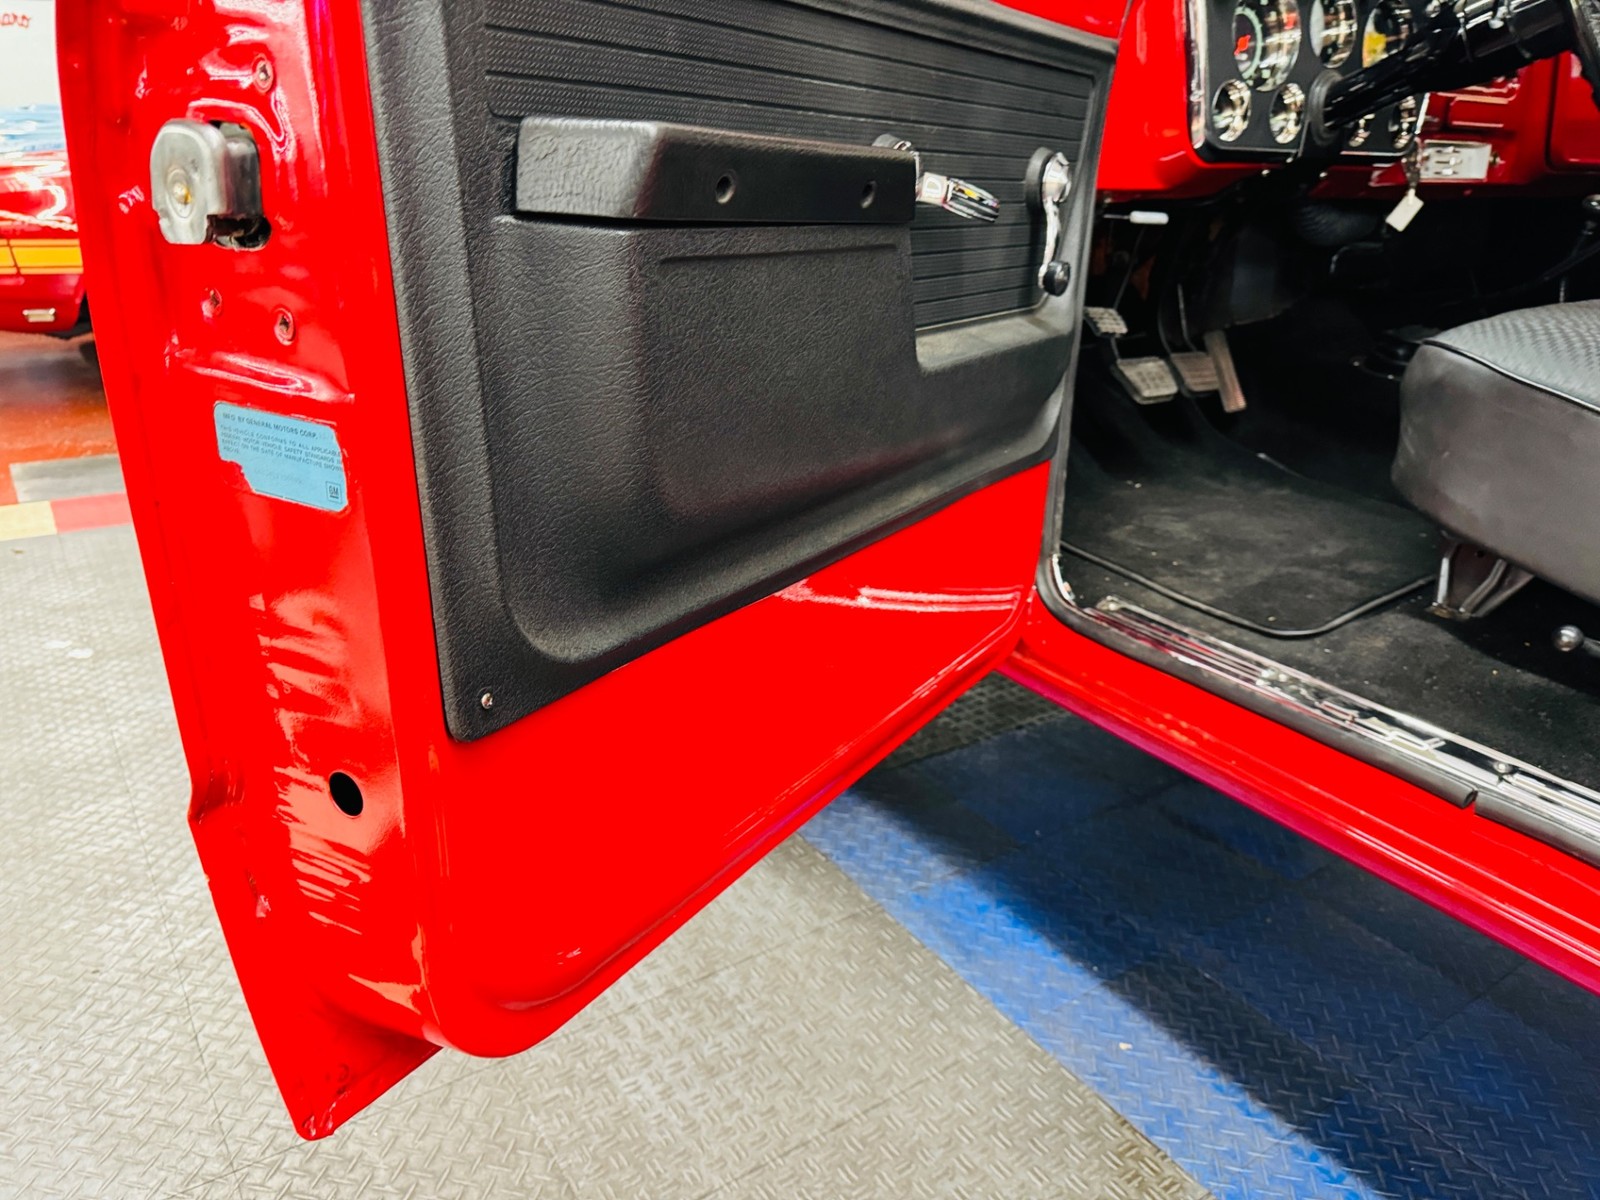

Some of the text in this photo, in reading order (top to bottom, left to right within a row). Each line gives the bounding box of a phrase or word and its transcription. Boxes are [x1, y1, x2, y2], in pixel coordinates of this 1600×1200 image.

[246, 417, 272, 429] GENERAL
[273, 423, 298, 435] MOTORS
[233, 427, 254, 437] VEHICLE
[255, 432, 287, 445] CONFORMS
[298, 442, 310, 451] ALL
[262, 441, 281, 450] VEHICLE
[284, 446, 303, 455] SAFETY
[304, 451, 335, 464] STANDARDS
[283, 454, 323, 468] MANUFACTURE
[328, 485, 339, 496] GM
